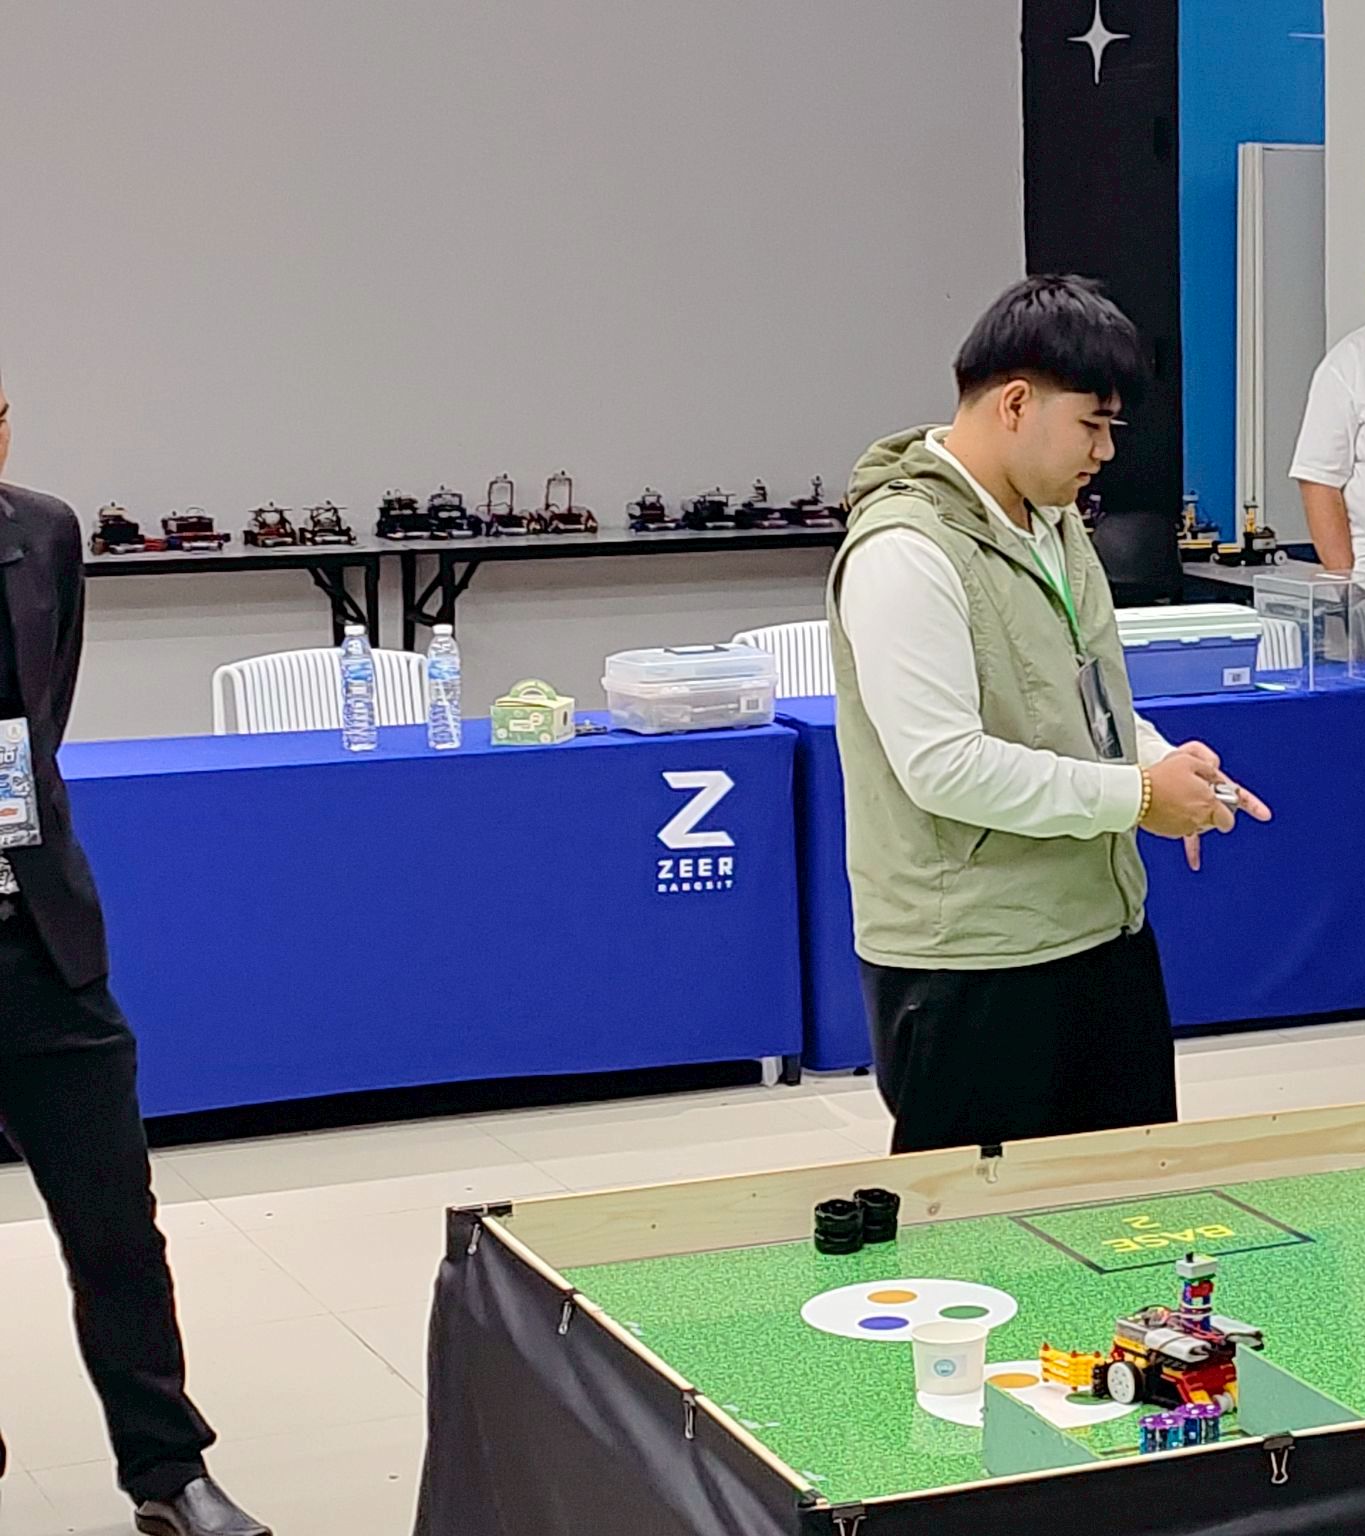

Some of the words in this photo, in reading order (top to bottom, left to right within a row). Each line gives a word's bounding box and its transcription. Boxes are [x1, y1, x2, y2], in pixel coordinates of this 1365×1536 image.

[657, 770, 735, 850] Z
[657, 857, 733, 879] ZEER
[1121, 1215, 1161, 1229] 2
[1101, 1224, 1236, 1253] BASE
